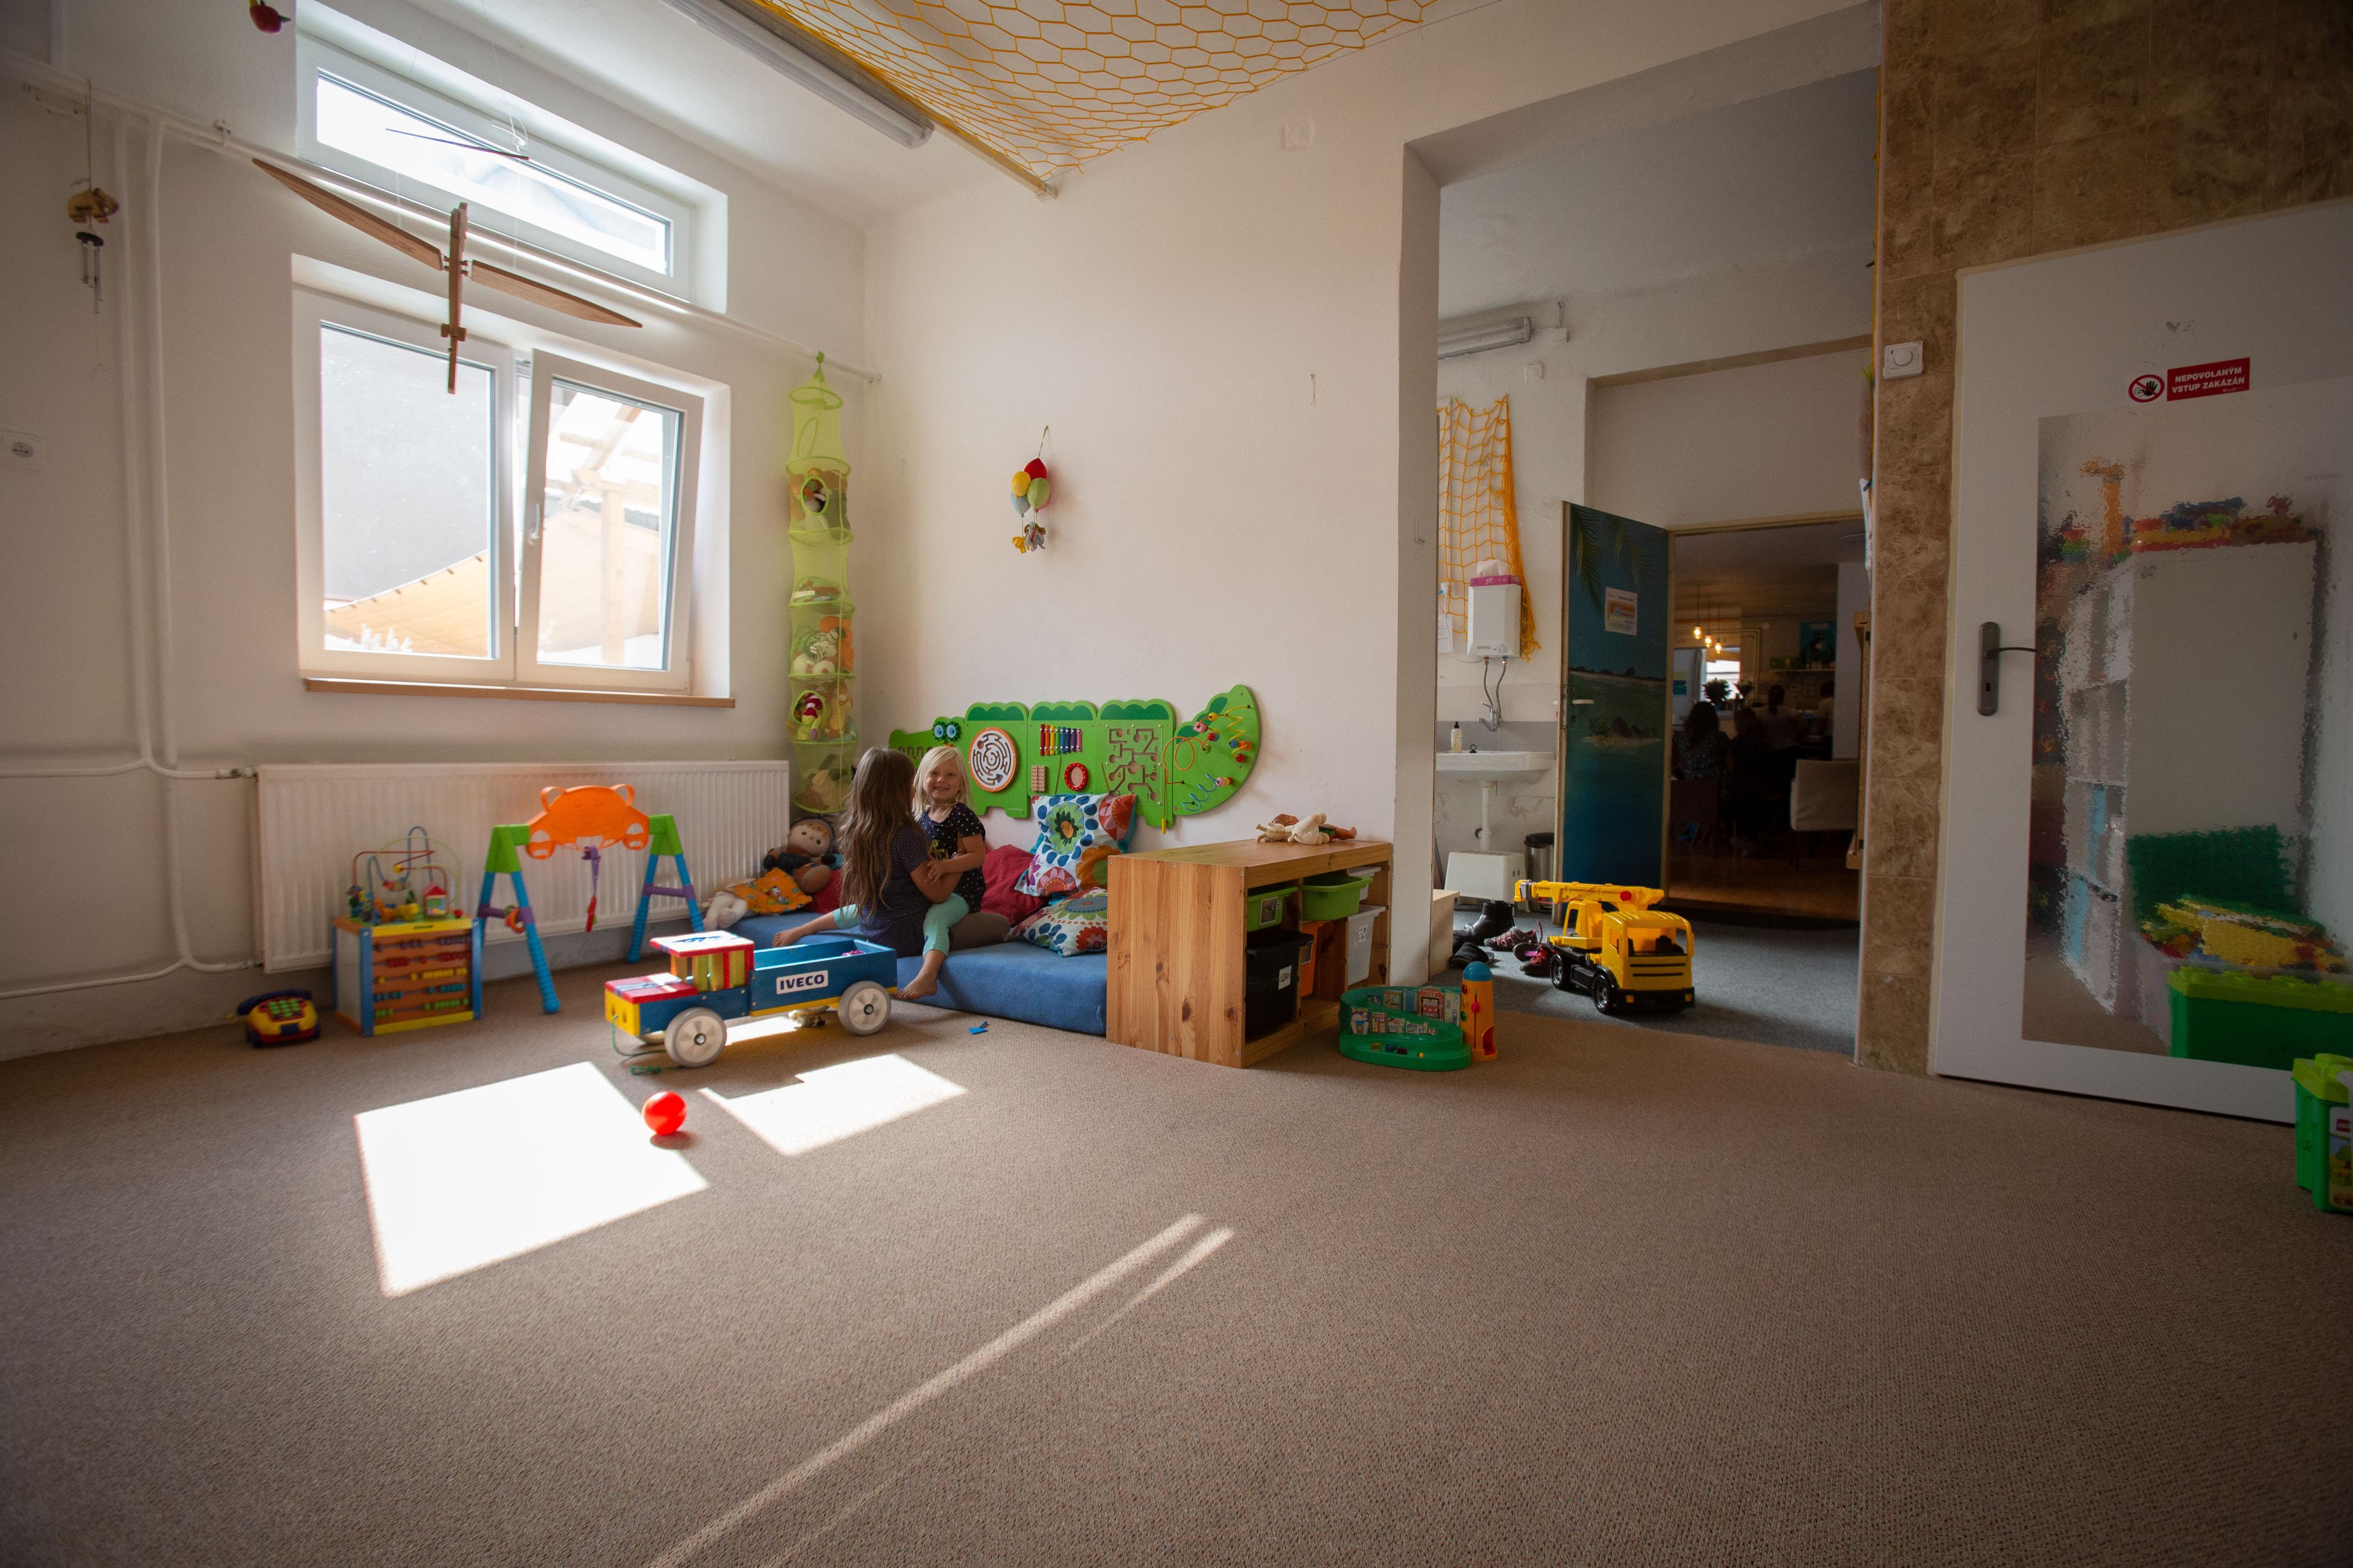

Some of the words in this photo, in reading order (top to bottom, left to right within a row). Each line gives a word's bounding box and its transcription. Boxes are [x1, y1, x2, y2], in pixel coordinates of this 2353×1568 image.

[2175, 366, 2242, 382] NEPOVOLANÝM
[2172, 383, 2200, 393] VSTUP
[2202, 376, 2245, 389] ZAKÁZÁN
[780, 974, 825, 990] IVECO
